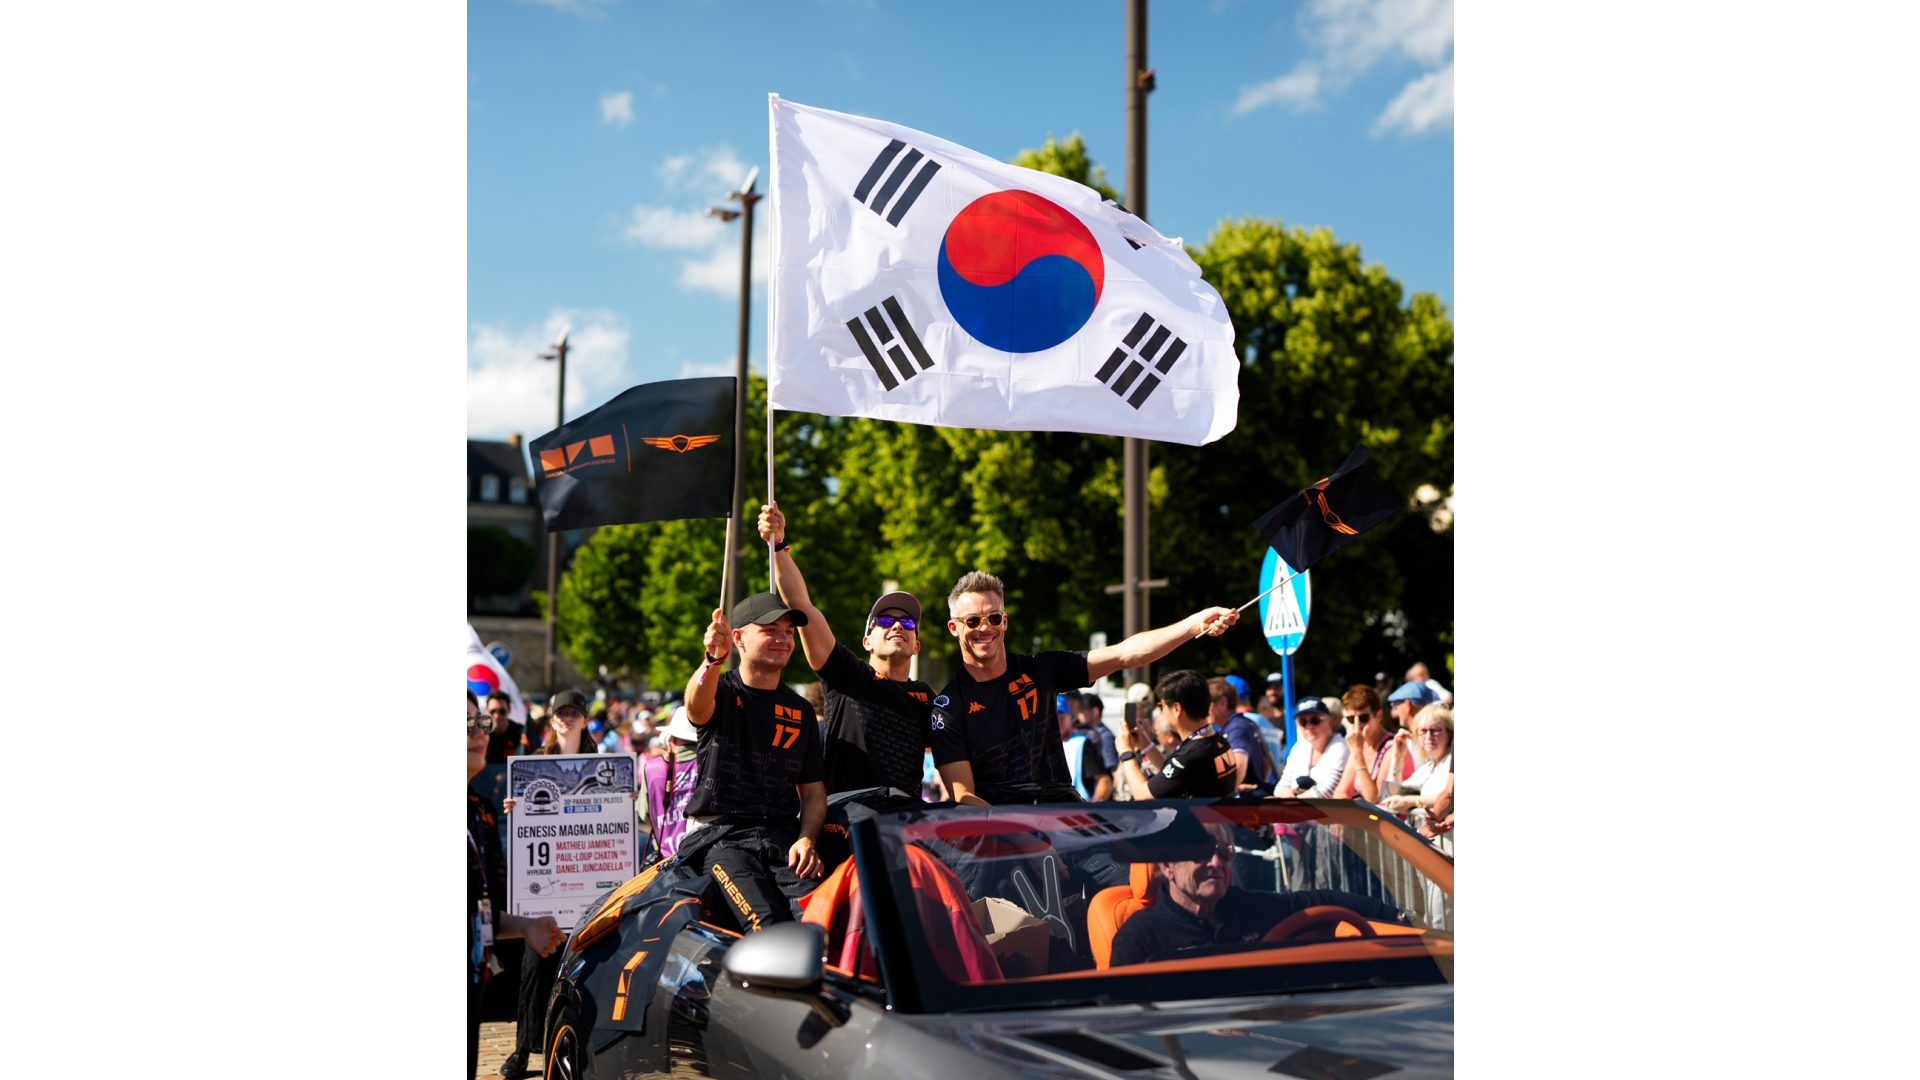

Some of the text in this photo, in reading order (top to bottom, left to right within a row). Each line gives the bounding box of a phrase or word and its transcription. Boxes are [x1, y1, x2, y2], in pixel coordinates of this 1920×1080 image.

[1017, 688, 1038, 720] 17
[772, 723, 800, 749] 17
[517, 822, 630, 838] GENESIS MAGMA RACING
[556, 841, 586, 851] MATHIEU
[587, 839, 615, 849] JAMINET
[526, 842, 550, 867] 19
[556, 852, 593, 862] PAUL-LOUP
[594, 851, 618, 860] CHATIN
[527, 868, 552, 876] HYPERCAR
[556, 864, 580, 874] DANIEL
[582, 862, 624, 872] JUNCADELLA
[711, 863, 752, 916] GENESIS
